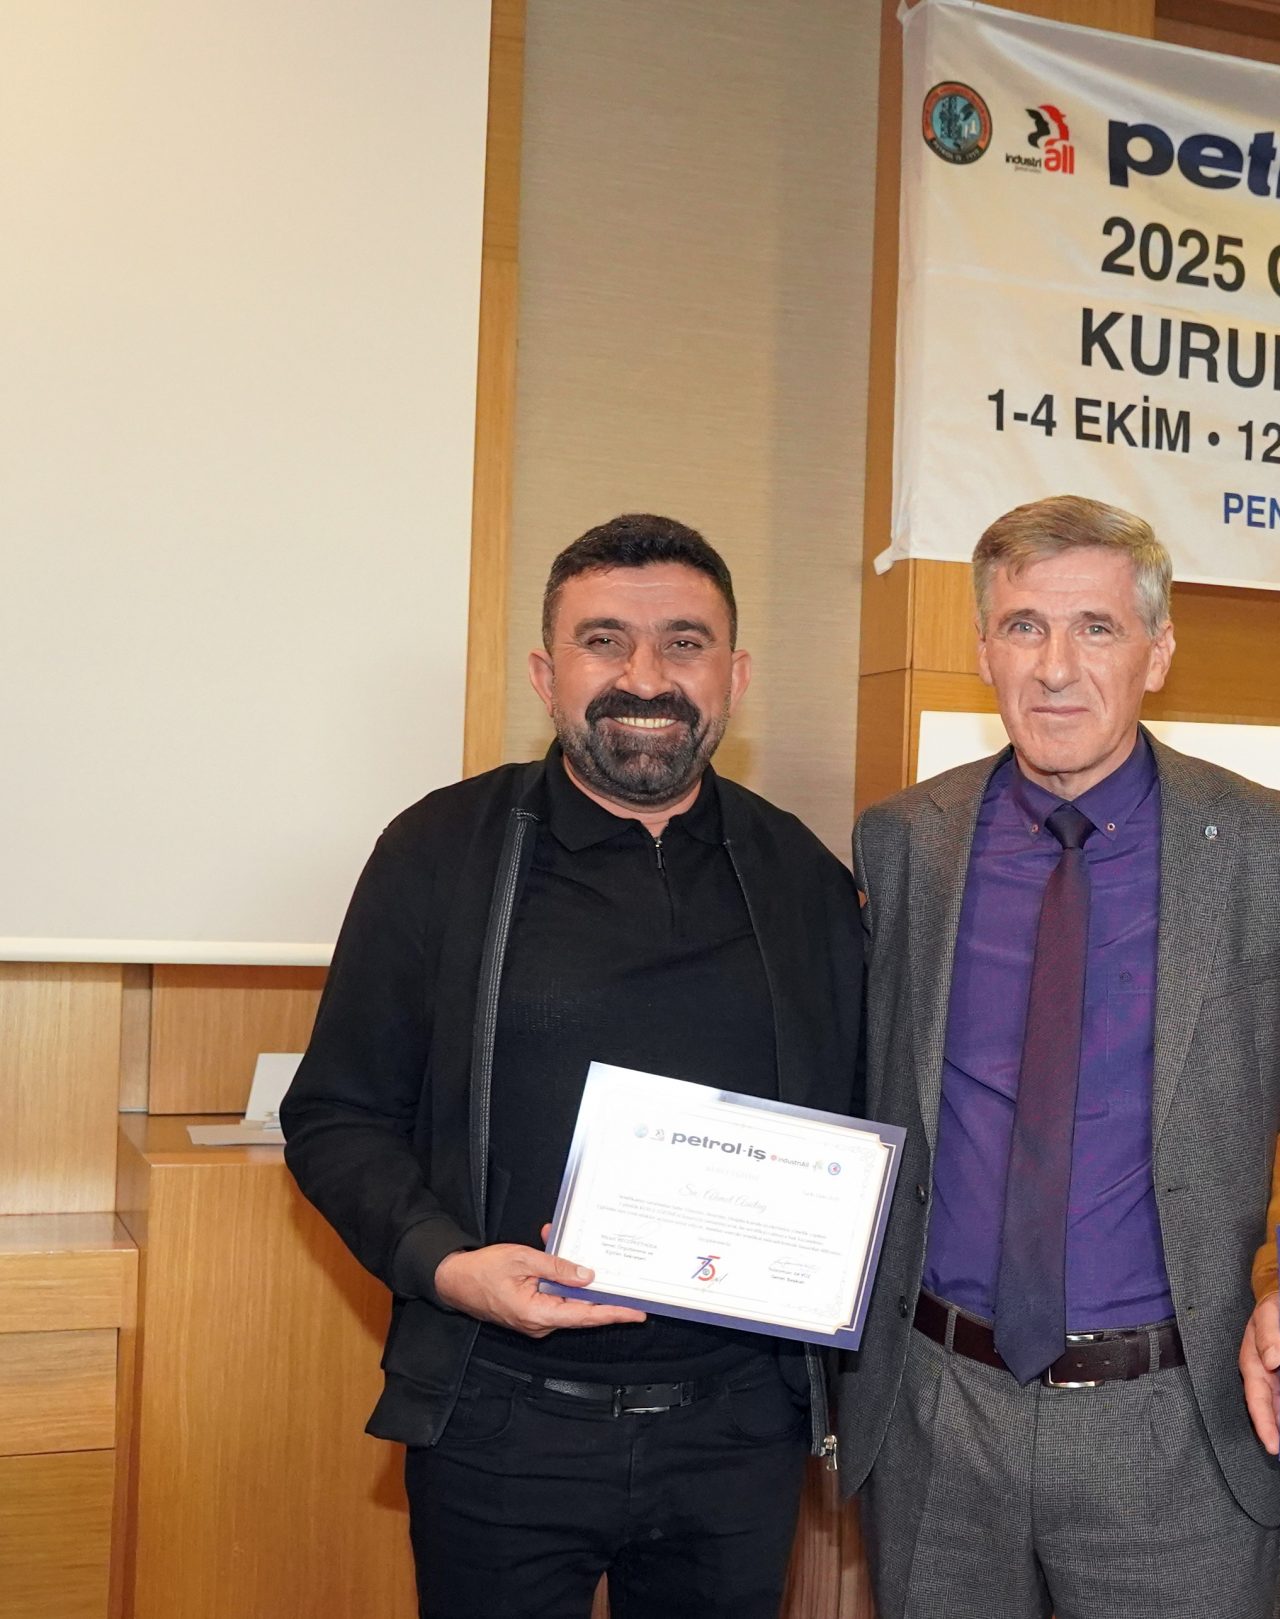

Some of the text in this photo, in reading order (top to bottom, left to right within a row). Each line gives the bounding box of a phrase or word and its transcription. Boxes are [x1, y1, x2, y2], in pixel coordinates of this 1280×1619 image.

[1101, 216, 1246, 292] 2025
[988, 389, 1057, 436] 1-4
[1075, 395, 1191, 453] EKİM
[670, 1130, 767, 1162] petrol-iş
